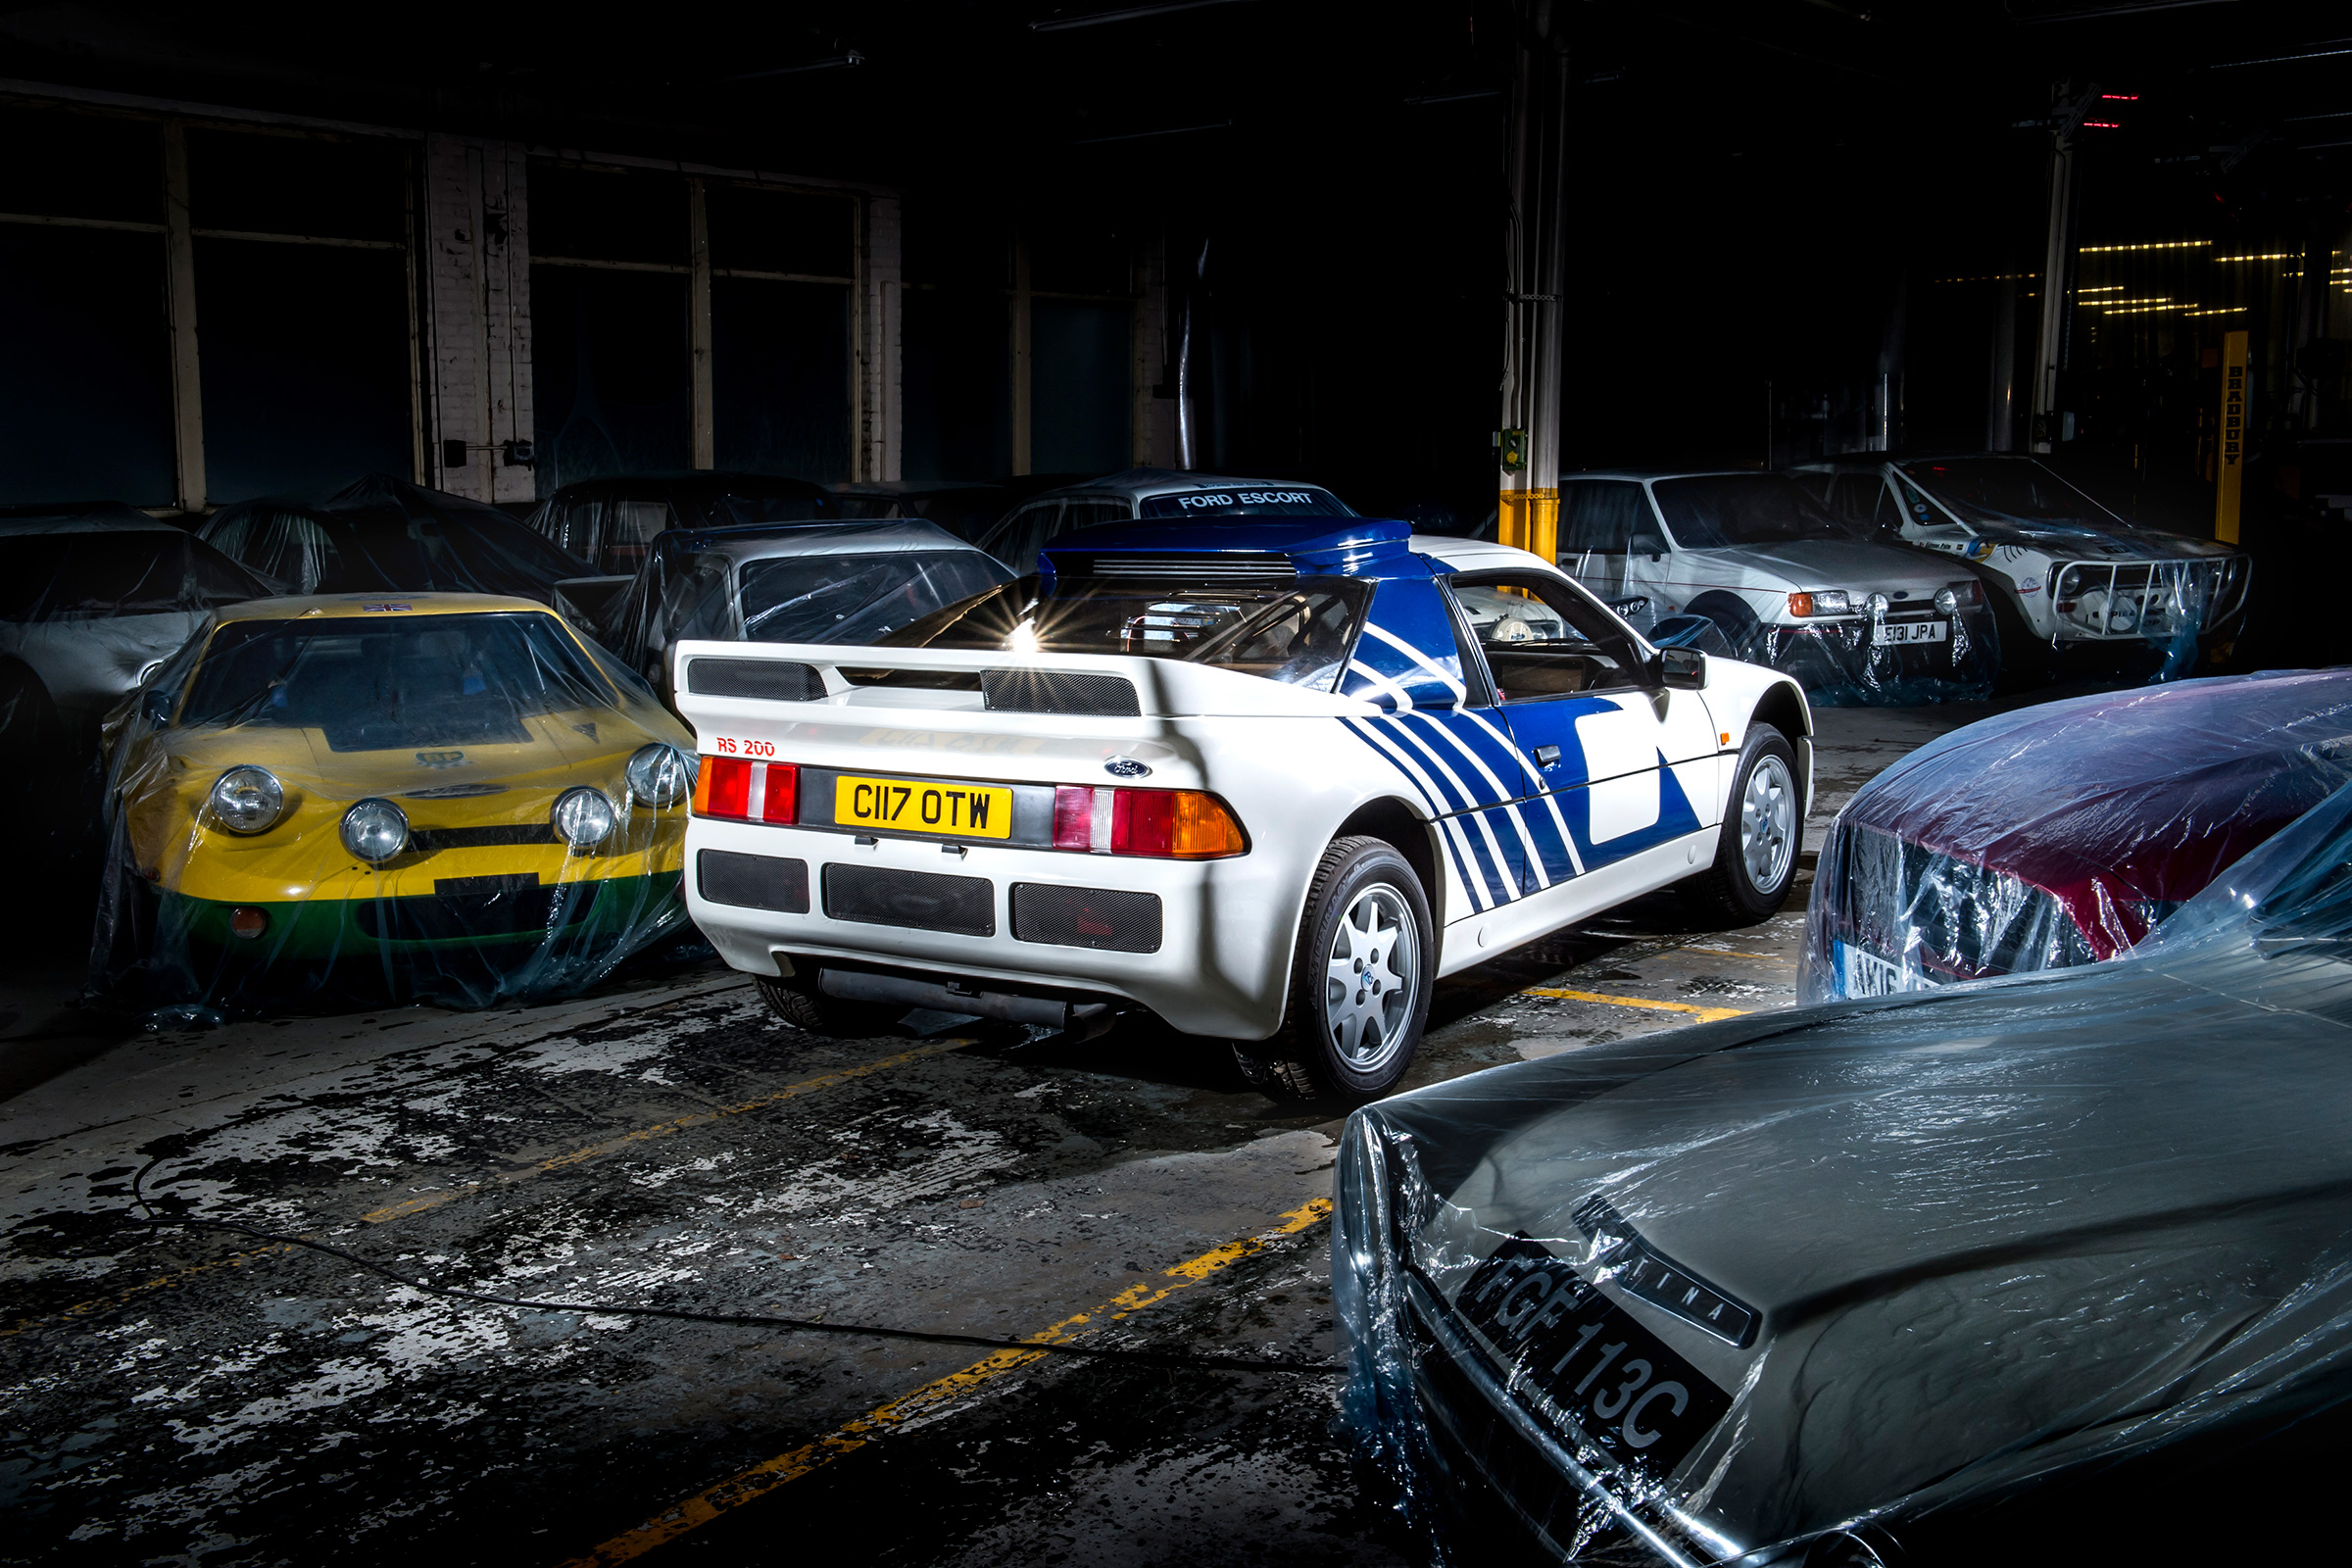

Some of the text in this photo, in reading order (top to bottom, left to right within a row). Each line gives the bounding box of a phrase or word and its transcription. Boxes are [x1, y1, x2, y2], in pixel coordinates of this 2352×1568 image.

[2224, 366, 2243, 466] BRADBURY
[1178, 491, 1313, 510] FORD ESCORT
[1911, 623, 1936, 640] JPA
[716, 737, 775, 758] RS 200
[1113, 761, 1139, 775] Ford
[854, 783, 991, 829] C117 OTW
[1474, 1252, 1690, 1449] FGF 113C
